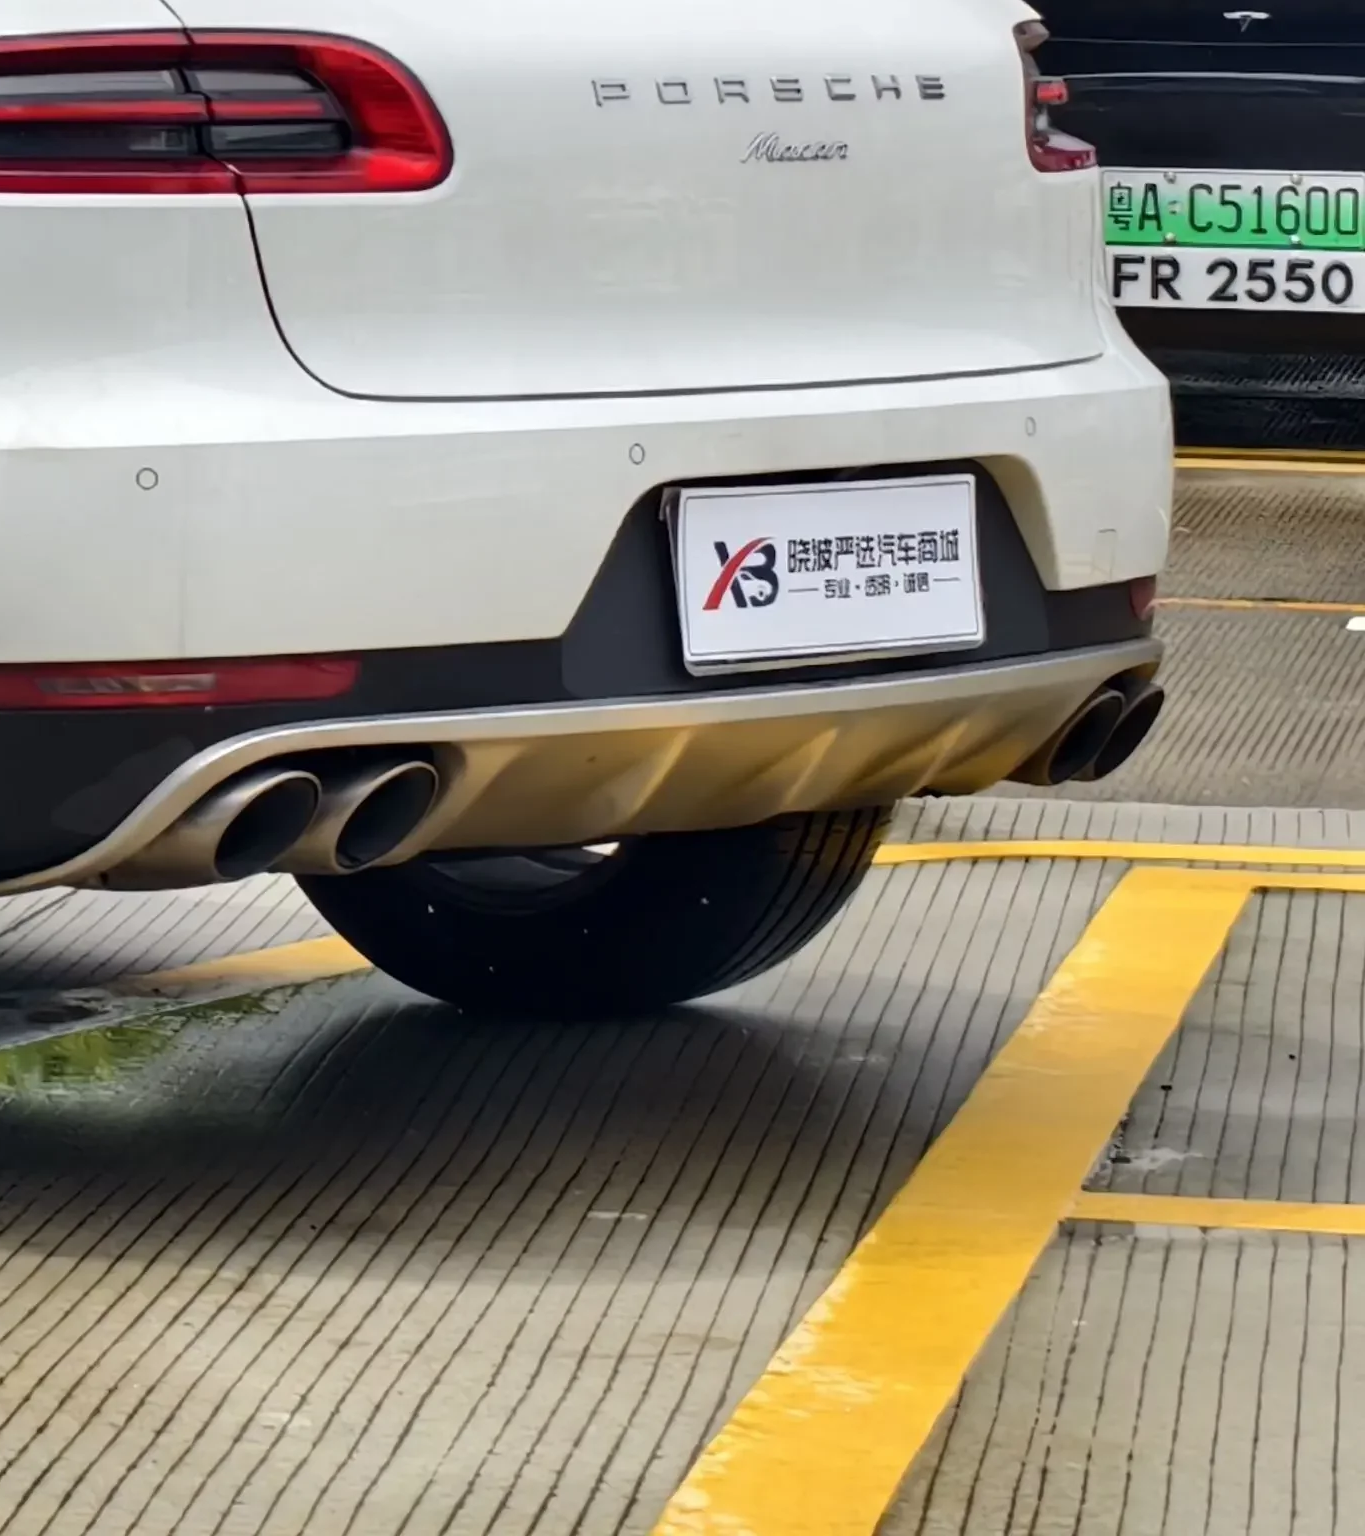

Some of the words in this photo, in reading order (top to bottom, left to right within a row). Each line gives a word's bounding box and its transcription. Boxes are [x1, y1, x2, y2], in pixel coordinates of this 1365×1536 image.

[591, 74, 947, 107] PORSCHE
[739, 131, 849, 164] Macan
[1112, 254, 1182, 301] FR
[1205, 258, 1354, 305] 2550
[786, 528, 962, 574] 晓波严选汽车商城
